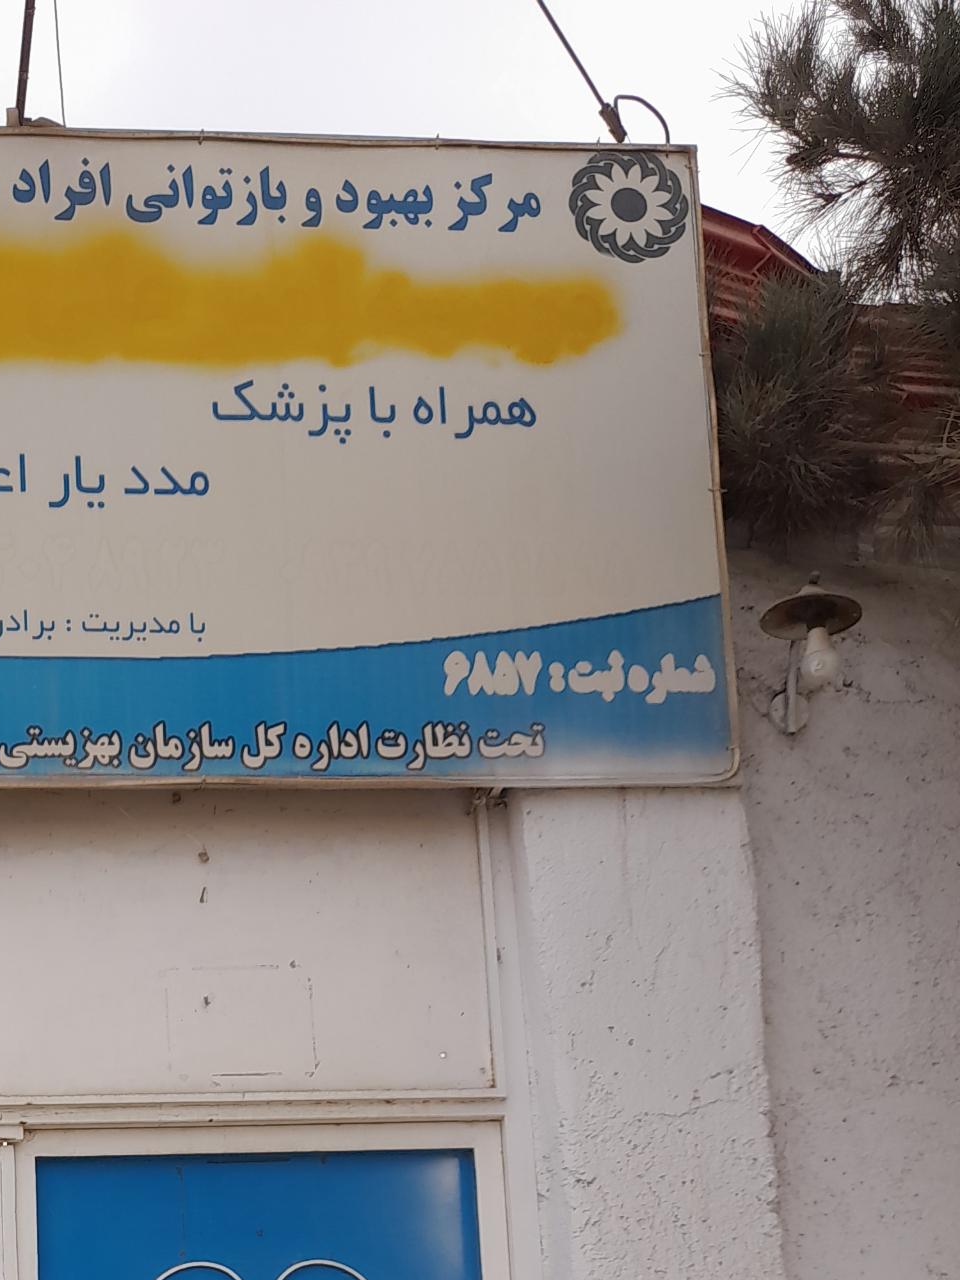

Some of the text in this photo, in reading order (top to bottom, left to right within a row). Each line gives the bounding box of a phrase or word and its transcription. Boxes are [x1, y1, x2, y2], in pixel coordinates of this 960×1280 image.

[12, 159, 111, 221] افراد
[126, 167, 287, 226] بازتوانی
[302, 188, 322, 228] و
[336, 184, 433, 229] بهبود
[448, 174, 541, 232] مرکز
[212, 380, 537, 444] همراه با پزشک
[48, 455, 106, 509] یار
[123, 464, 210, 496] مدد
[81, 612, 181, 642] مدیریت
[189, 611, 206, 642] با
[128, 721, 234, 772] سازمان
[241, 721, 287, 769] کل
[293, 721, 371, 771] اداره
[377, 721, 473, 770] نظارت
[477, 722, 546, 760] تحت
